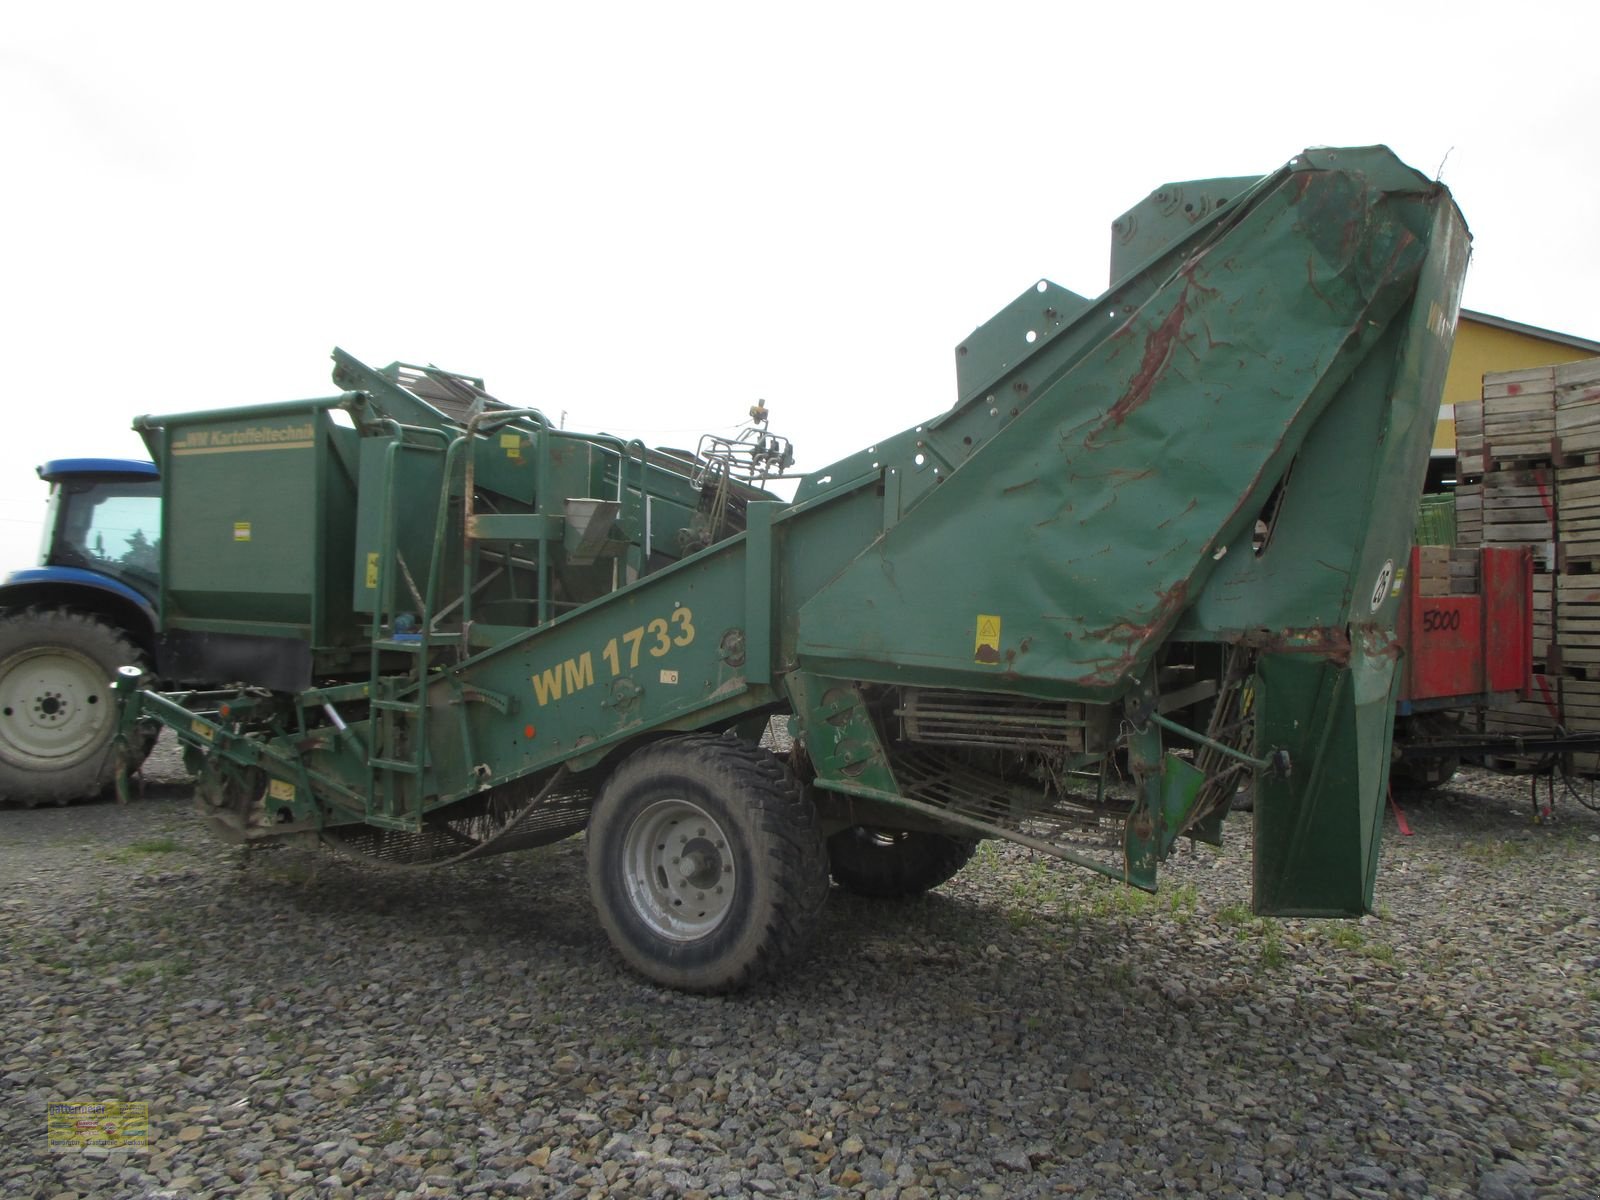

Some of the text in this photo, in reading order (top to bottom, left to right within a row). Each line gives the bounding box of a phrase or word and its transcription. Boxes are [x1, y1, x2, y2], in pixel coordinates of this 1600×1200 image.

[1423, 609, 1459, 632] 5000
[532, 607, 696, 706] WM 1733
